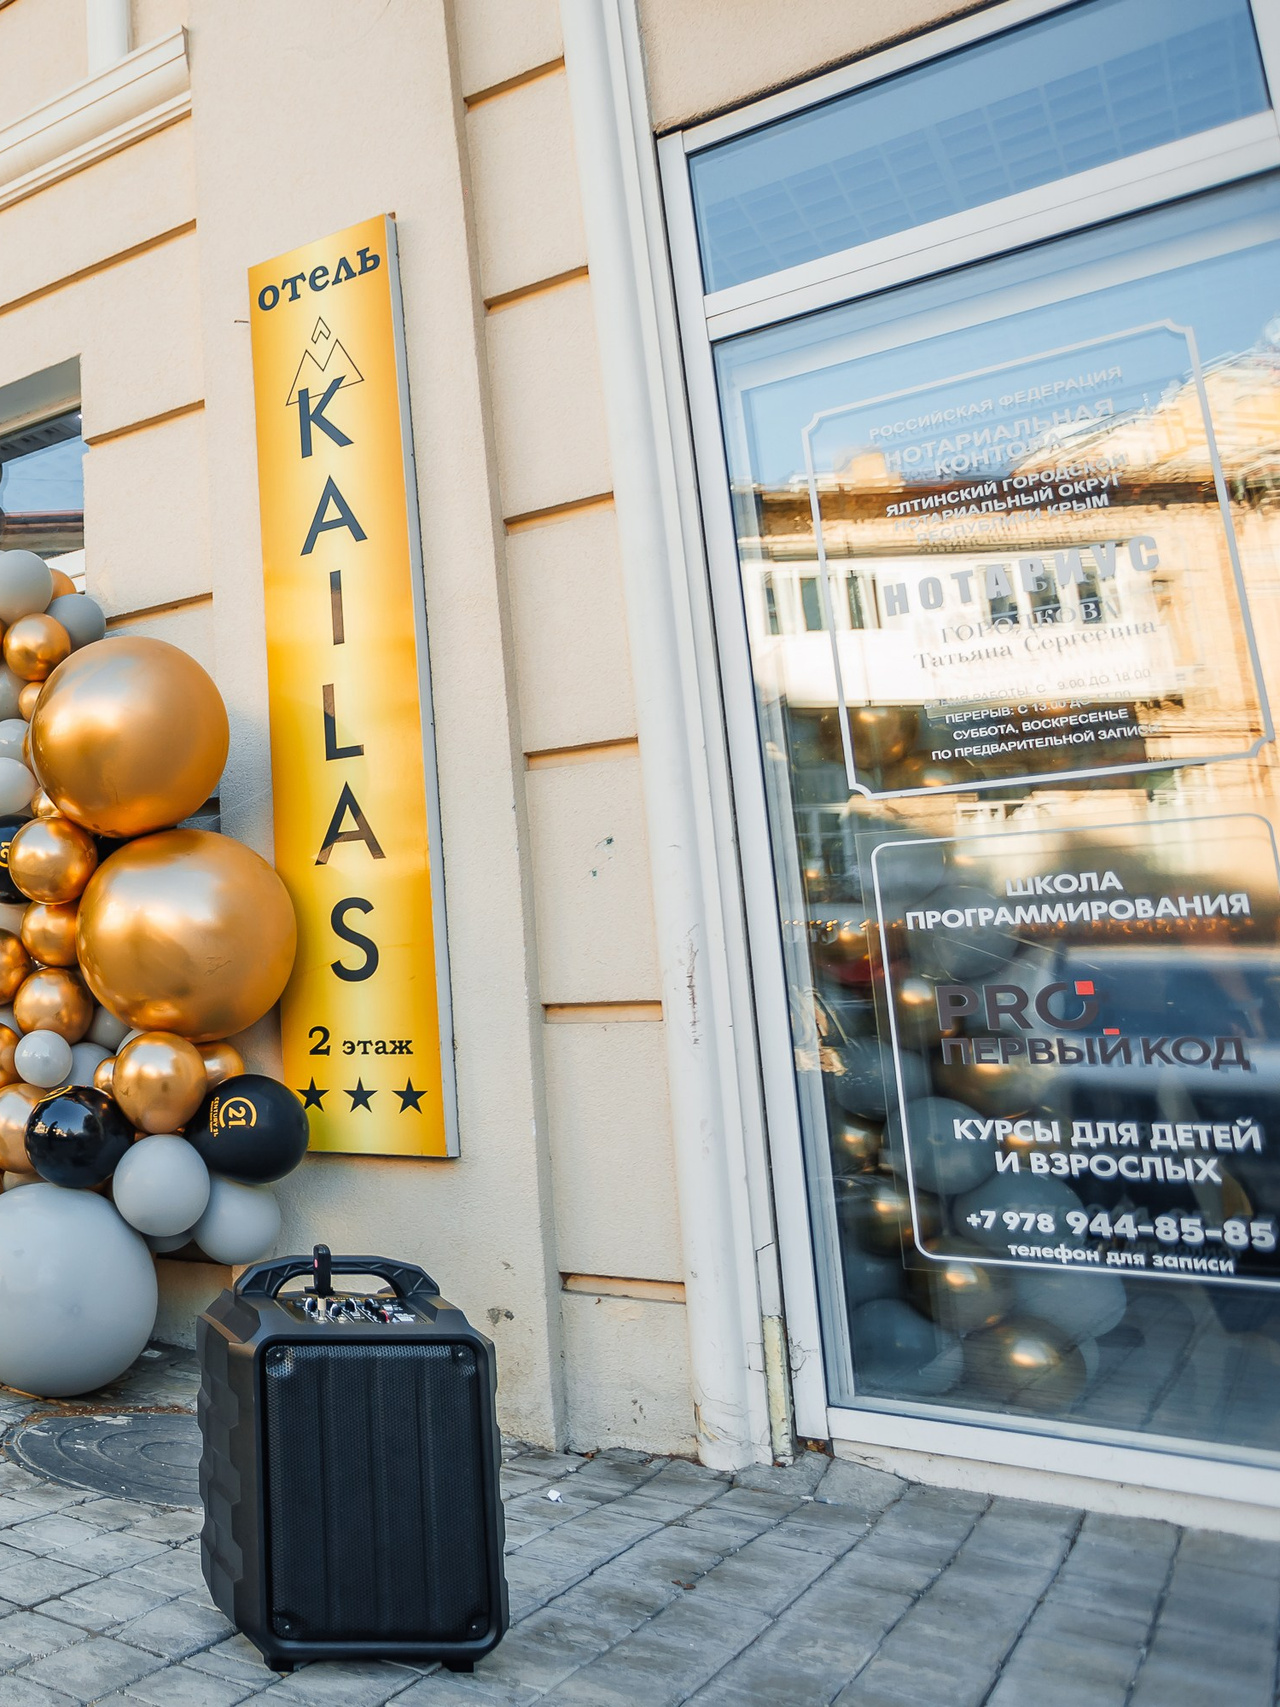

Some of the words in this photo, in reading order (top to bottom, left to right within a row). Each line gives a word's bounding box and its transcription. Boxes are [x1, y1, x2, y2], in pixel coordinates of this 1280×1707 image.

[869, 399, 993, 440] РОССИЙСКАЯ
[998, 366, 1122, 407] ФЕДЕРАЦИЯ
[885, 397, 1115, 468] НОТАРИАЛЬНАЯ
[933, 430, 1064, 477] КОНТОРА
[886, 480, 998, 517] ЯЛТИНСКИЙ
[1002, 453, 1127, 493] ГОРОДСКОЙ
[894, 486, 1054, 532] НОТАРИАЛЬНЫЙ
[1058, 472, 1124, 497] ОКРУГ
[917, 507, 1043, 544] РЕСПУБЛИКИ
[1046, 493, 1109, 517] КРЫМ
[882, 535, 1160, 617] НОТАРИУС
[913, 644, 1013, 670] Татьяна
[1023, 620, 1157, 656] Сергеевна
[297, 374, 387, 983] KAILAS
[945, 707, 1015, 725] ПЕРЕРЫВ:
[953, 724, 1019, 741] СУББОТА,
[1022, 708, 1129, 732] ВОСКРЕСЕНЬЕ
[931, 750, 952, 761] ПО
[954, 729, 1096, 759] ПРЕДВАРИТЕЛЬНОЙ
[1005, 871, 1124, 897] ШКОЛА
[905, 893, 1251, 930] ПРОГРАММИРОВАНИЯ
[934, 980, 1100, 1031] PRO
[308, 1025, 332, 1056] 2
[342, 1036, 414, 1056] этаж
[941, 1028, 1133, 1065] ПЕРВЫЙ
[1139, 1036, 1251, 1071] КОД
[952, 1118, 1061, 1144] КУРСЫ
[1070, 1120, 1140, 1148] ДЛЯ
[1150, 1118, 1263, 1151] ДЕТЕЙ
[994, 1151, 1020, 1173] И
[1029, 1152, 1222, 1183] ВЗРОСЛЫХ
[966, 1209, 997, 1230] +7
[1002, 1211, 1055, 1233] 978
[1065, 1211, 1276, 1249] 944-85-85
[1007, 1243, 1099, 1264] телефон
[1106, 1250, 1145, 1267] для
[1151, 1253, 1235, 1275] записи
